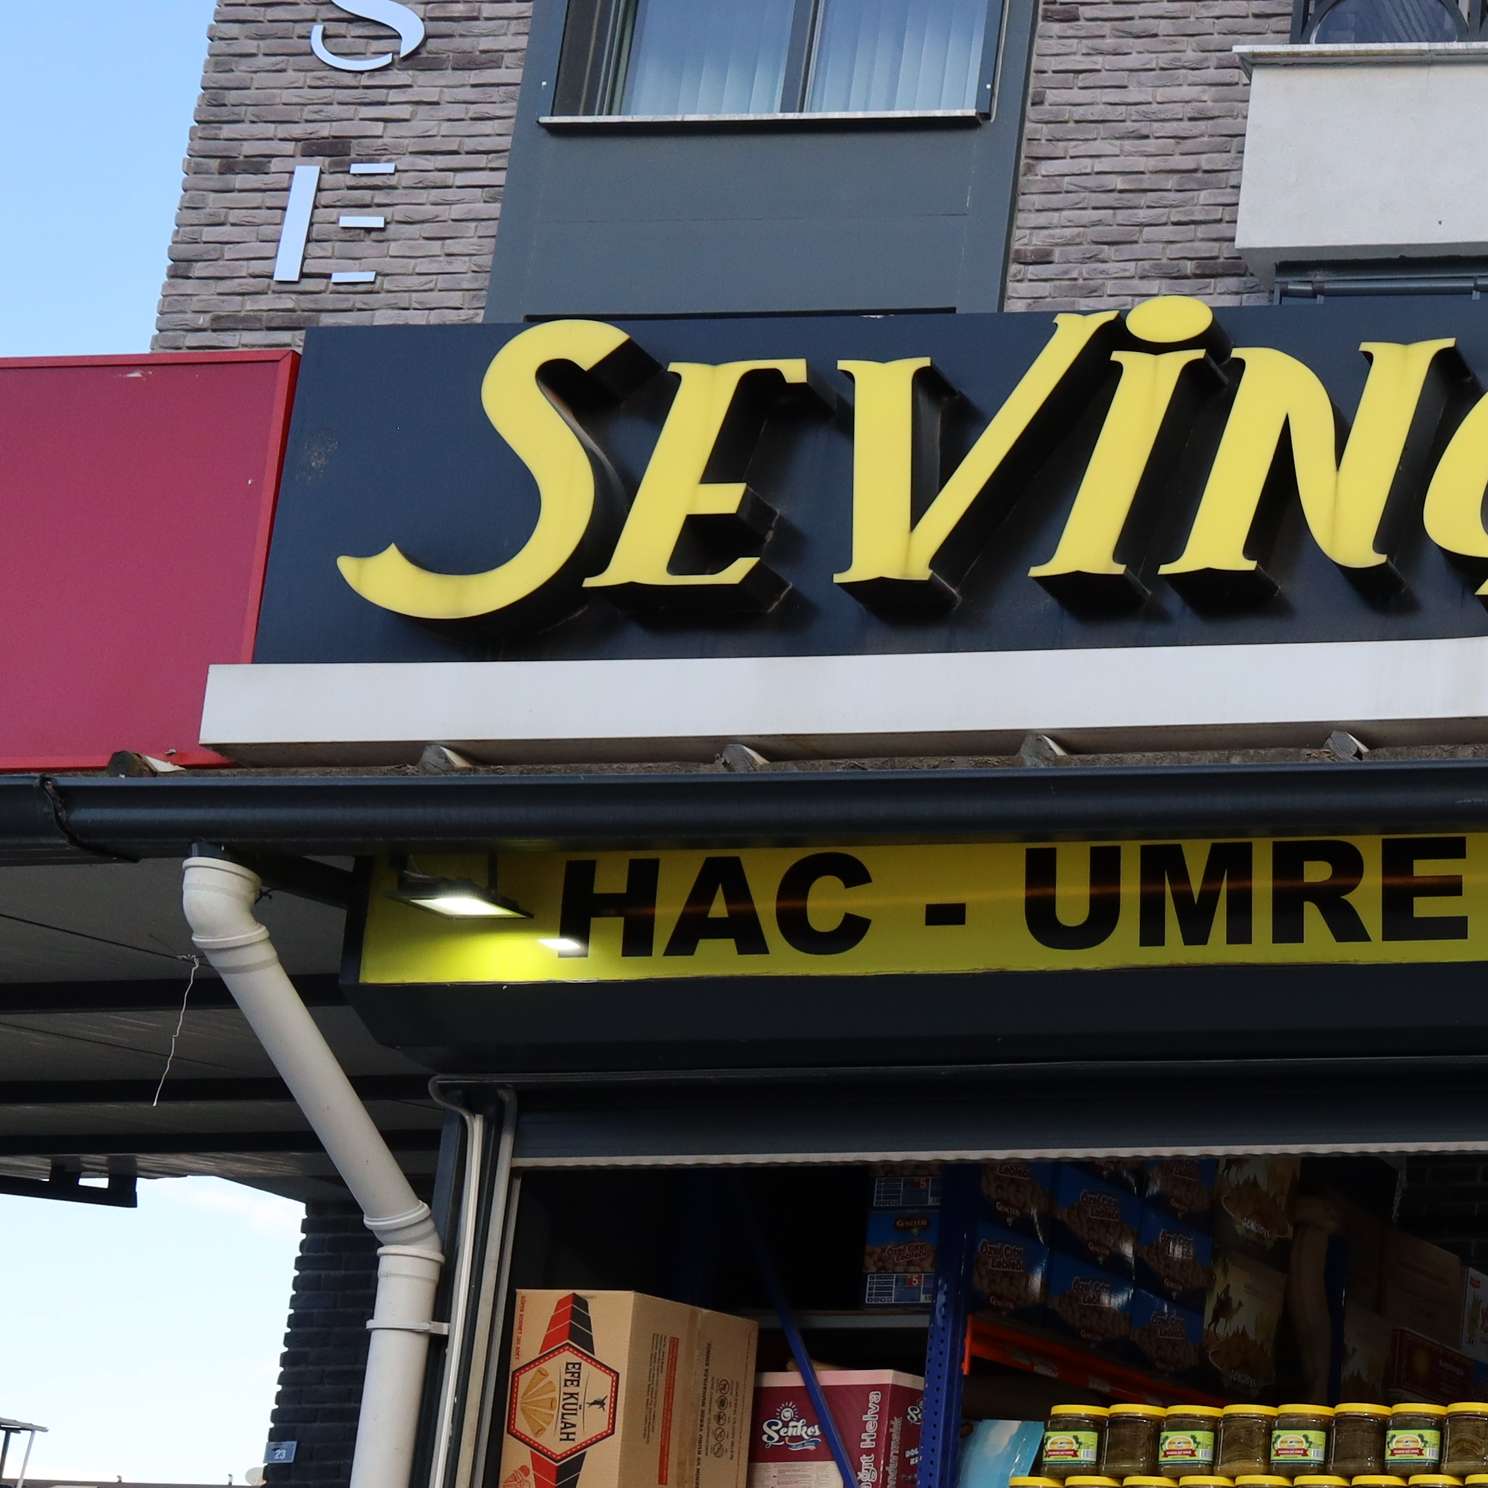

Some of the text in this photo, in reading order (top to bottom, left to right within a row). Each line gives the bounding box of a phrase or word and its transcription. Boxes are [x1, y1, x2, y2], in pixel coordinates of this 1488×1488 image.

[557, 851, 873, 958] HAC
[1024, 836, 1469, 951] UMRE
[559, 1361, 582, 1442] EFE KÜLAH
[860, 1390, 882, 1449] Helva
[274, 1449, 286, 1460] 23
